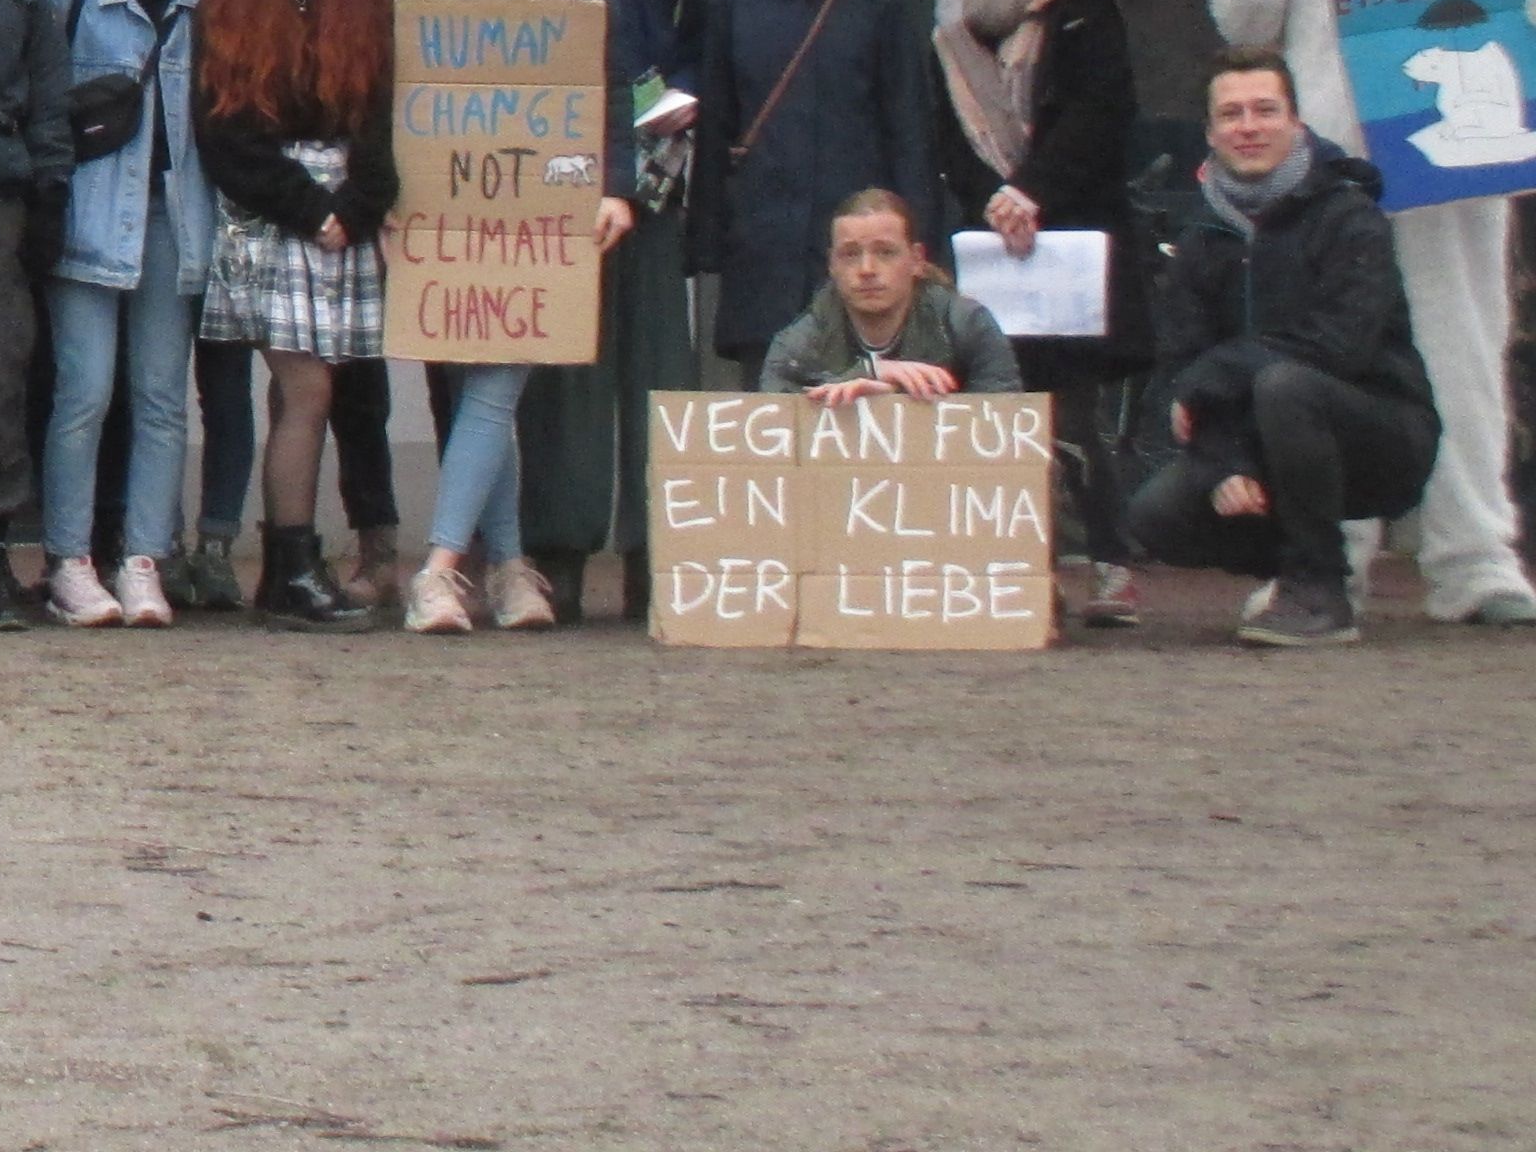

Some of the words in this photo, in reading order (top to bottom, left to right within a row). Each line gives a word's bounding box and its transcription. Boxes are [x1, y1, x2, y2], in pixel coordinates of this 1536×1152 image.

[418, 15, 567, 68] HUMAN
[404, 86, 584, 138] CHANGE
[450, 148, 538, 199] NOT
[402, 212, 576, 266] CLIMATE
[418, 281, 549, 341] CHANGE
[658, 396, 903, 463] VEGAN
[935, 400, 1051, 460] FÜR
[664, 476, 785, 529] EIN
[846, 477, 1048, 544] KLIMA
[670, 558, 790, 619] DER
[838, 560, 1033, 623] LIEBE
